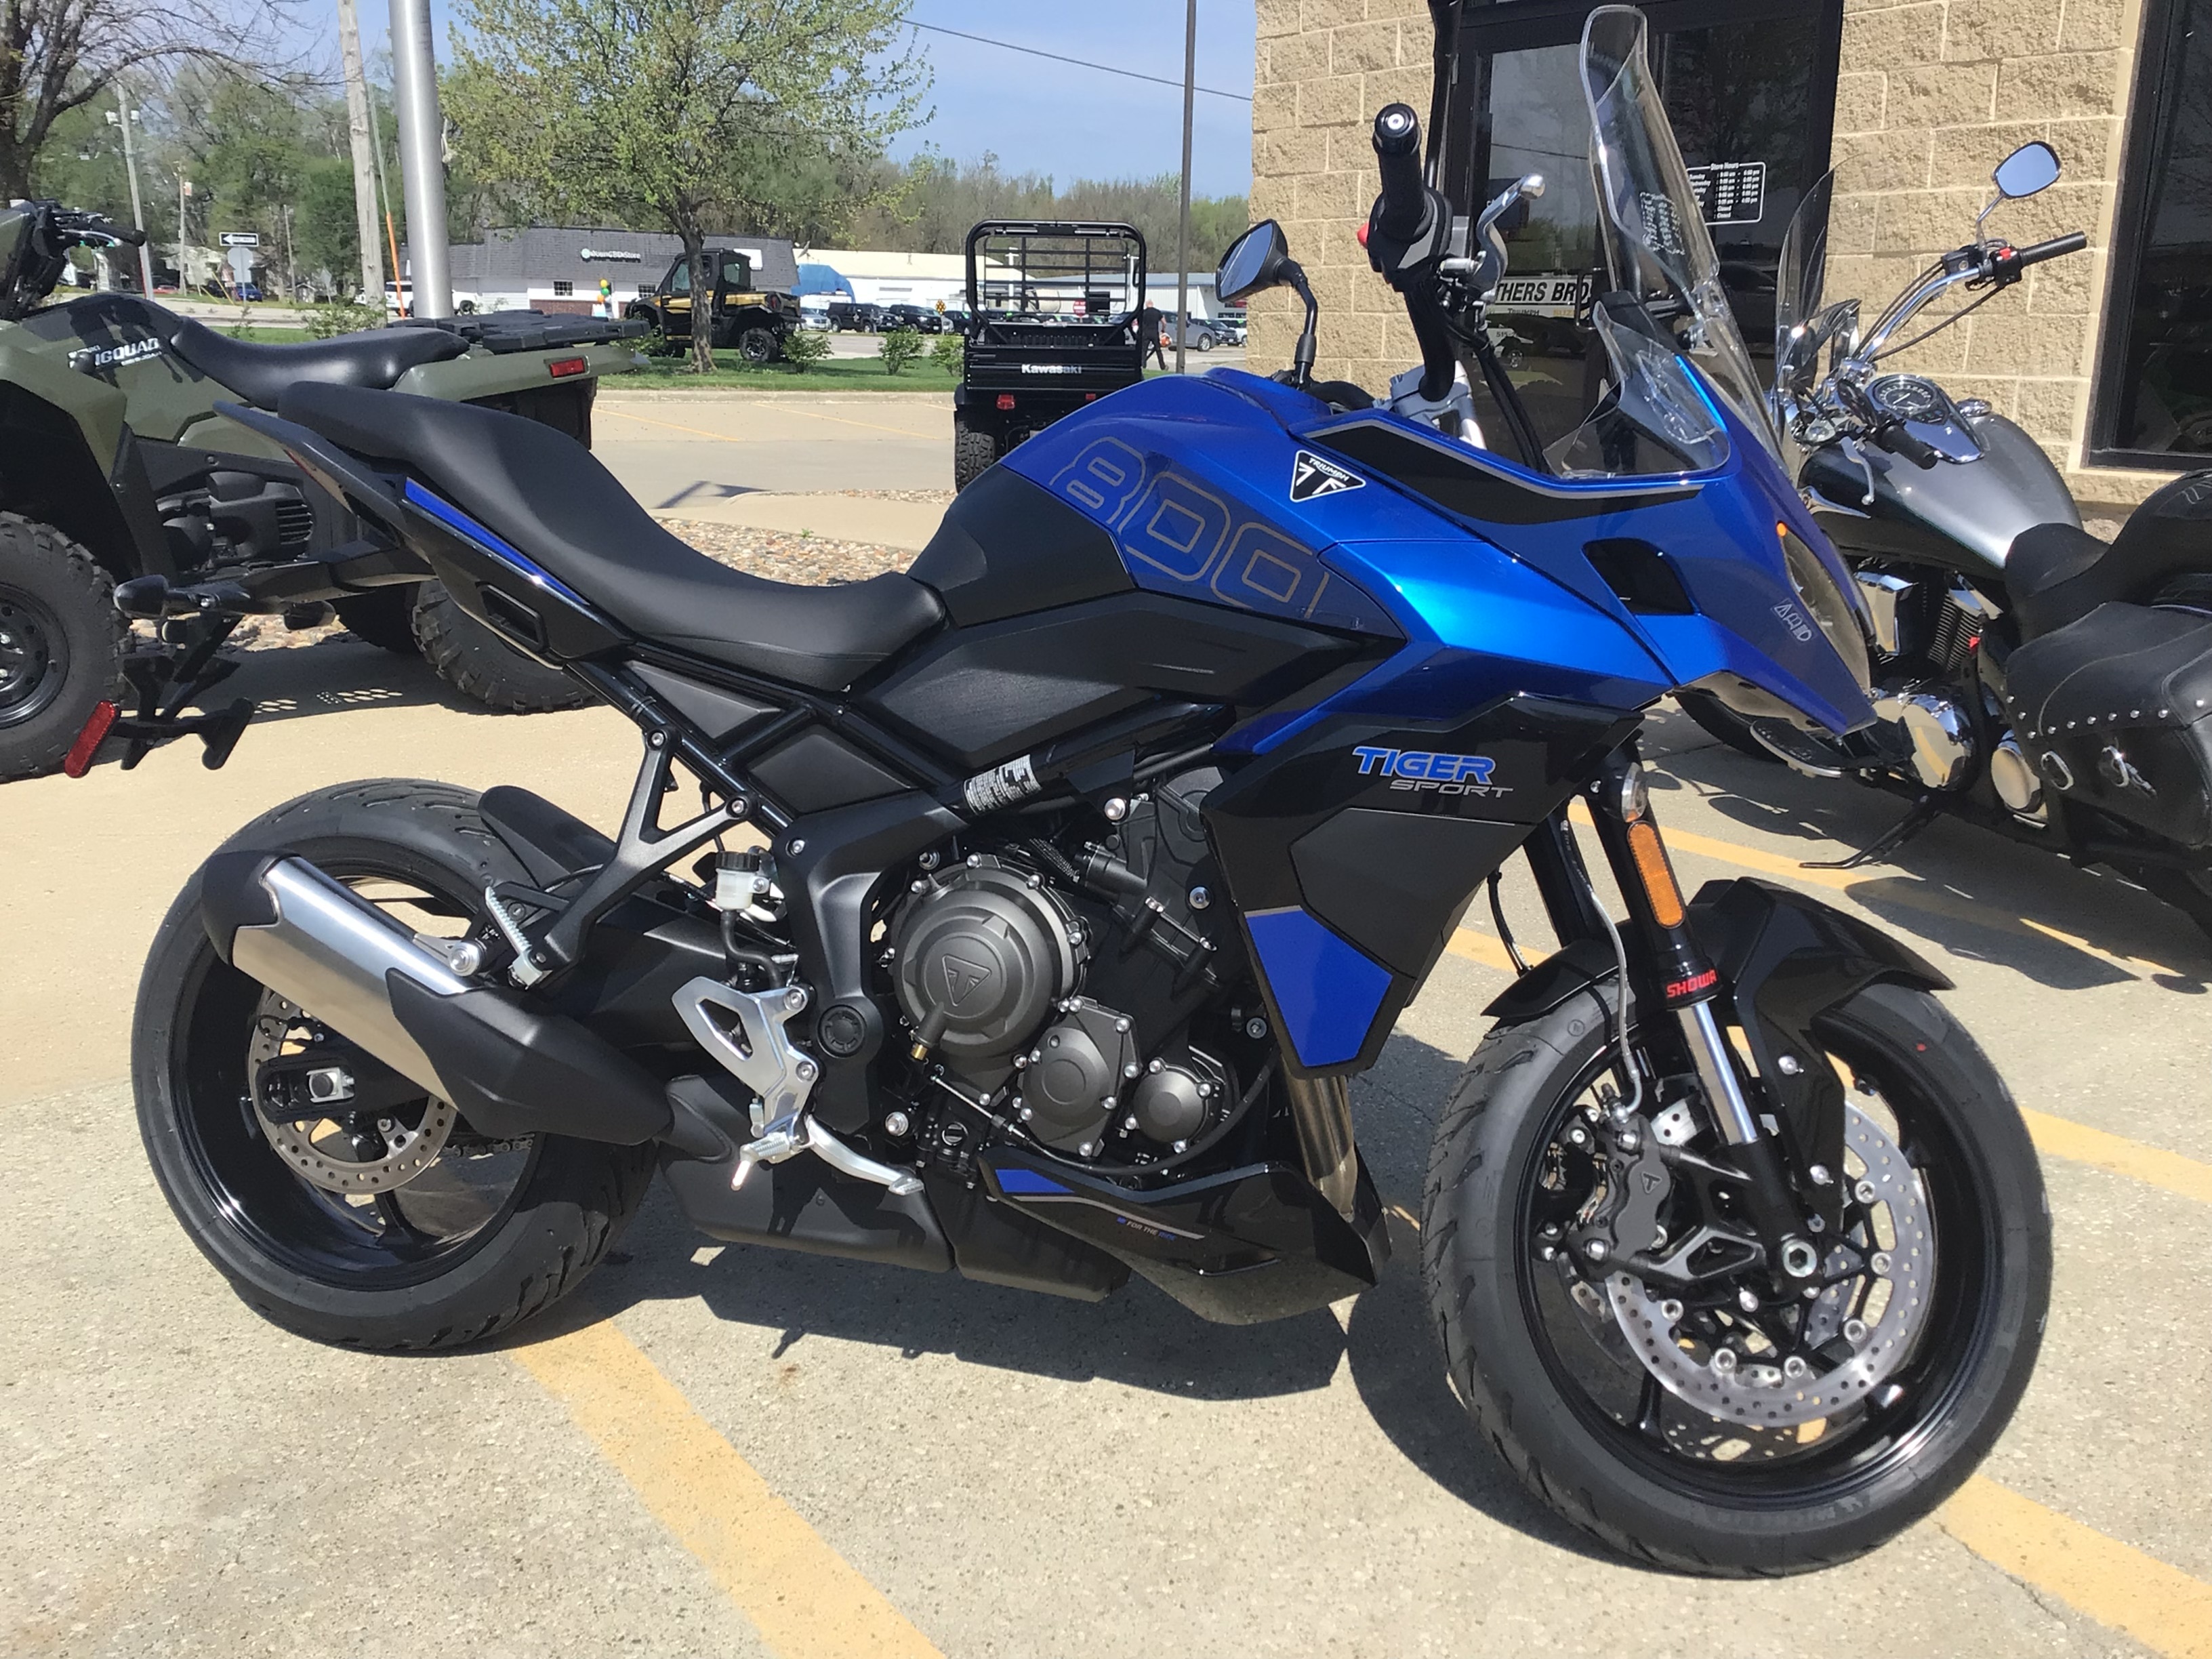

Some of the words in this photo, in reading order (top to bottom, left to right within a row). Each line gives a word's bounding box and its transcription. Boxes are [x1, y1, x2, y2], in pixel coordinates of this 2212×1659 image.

[1496, 281, 1547, 302] THERS
[1021, 364, 1082, 374] Kawasaki
[1309, 457, 1350, 482] TRIUMPH
[1351, 745, 1496, 785] TIGER
[1389, 779, 1514, 798] SPORT
[1666, 968, 1718, 999] SHOWA
